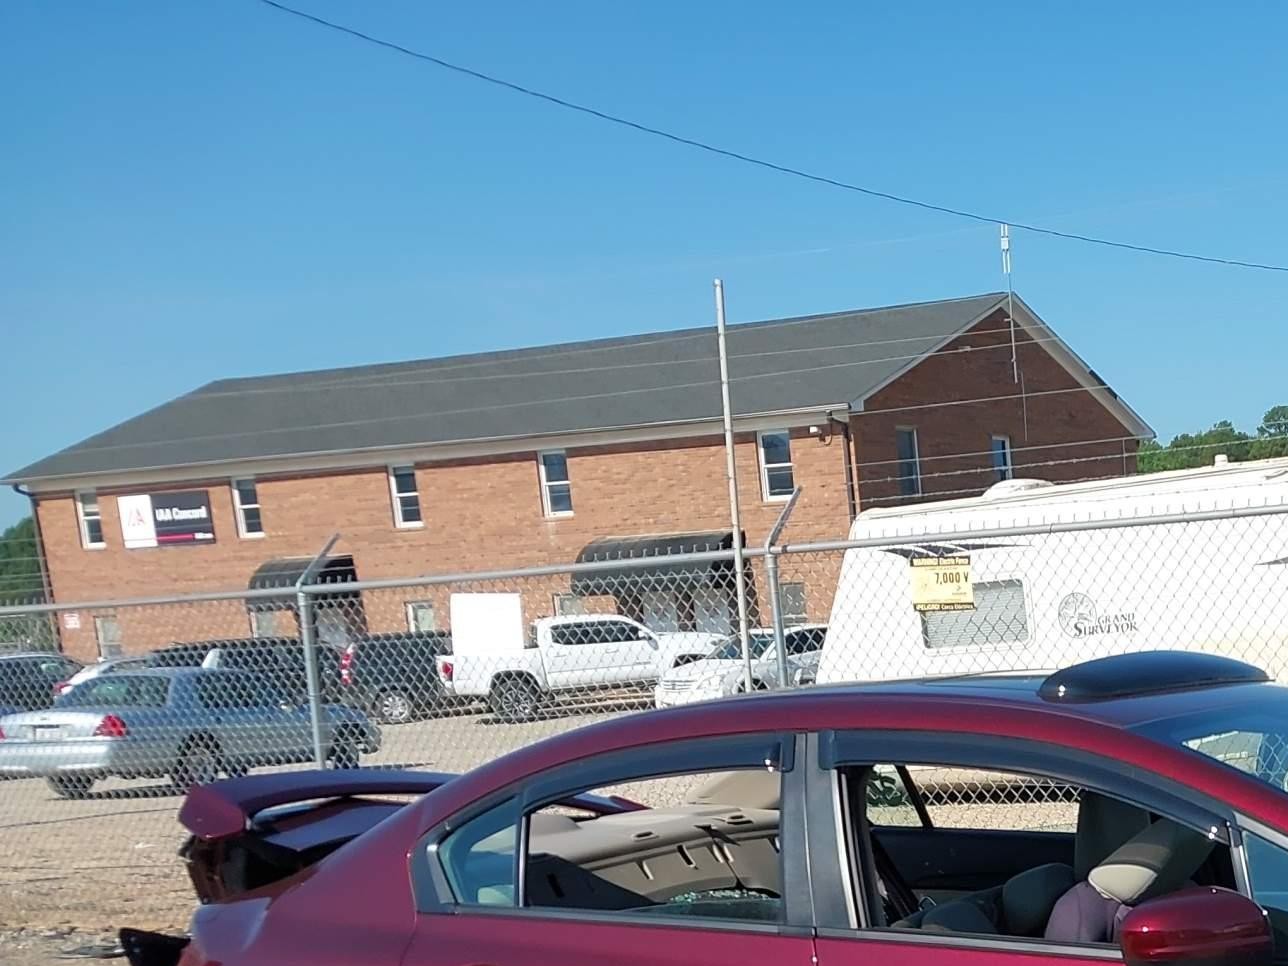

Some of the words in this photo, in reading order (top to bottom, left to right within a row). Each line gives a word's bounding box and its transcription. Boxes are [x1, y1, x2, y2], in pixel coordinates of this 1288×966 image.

[935, 571, 961, 585] 7,000
[963, 571, 969, 583] V
[1097, 612, 1135, 624] GRAND
[1073, 621, 1139, 638] SURVEYOR
